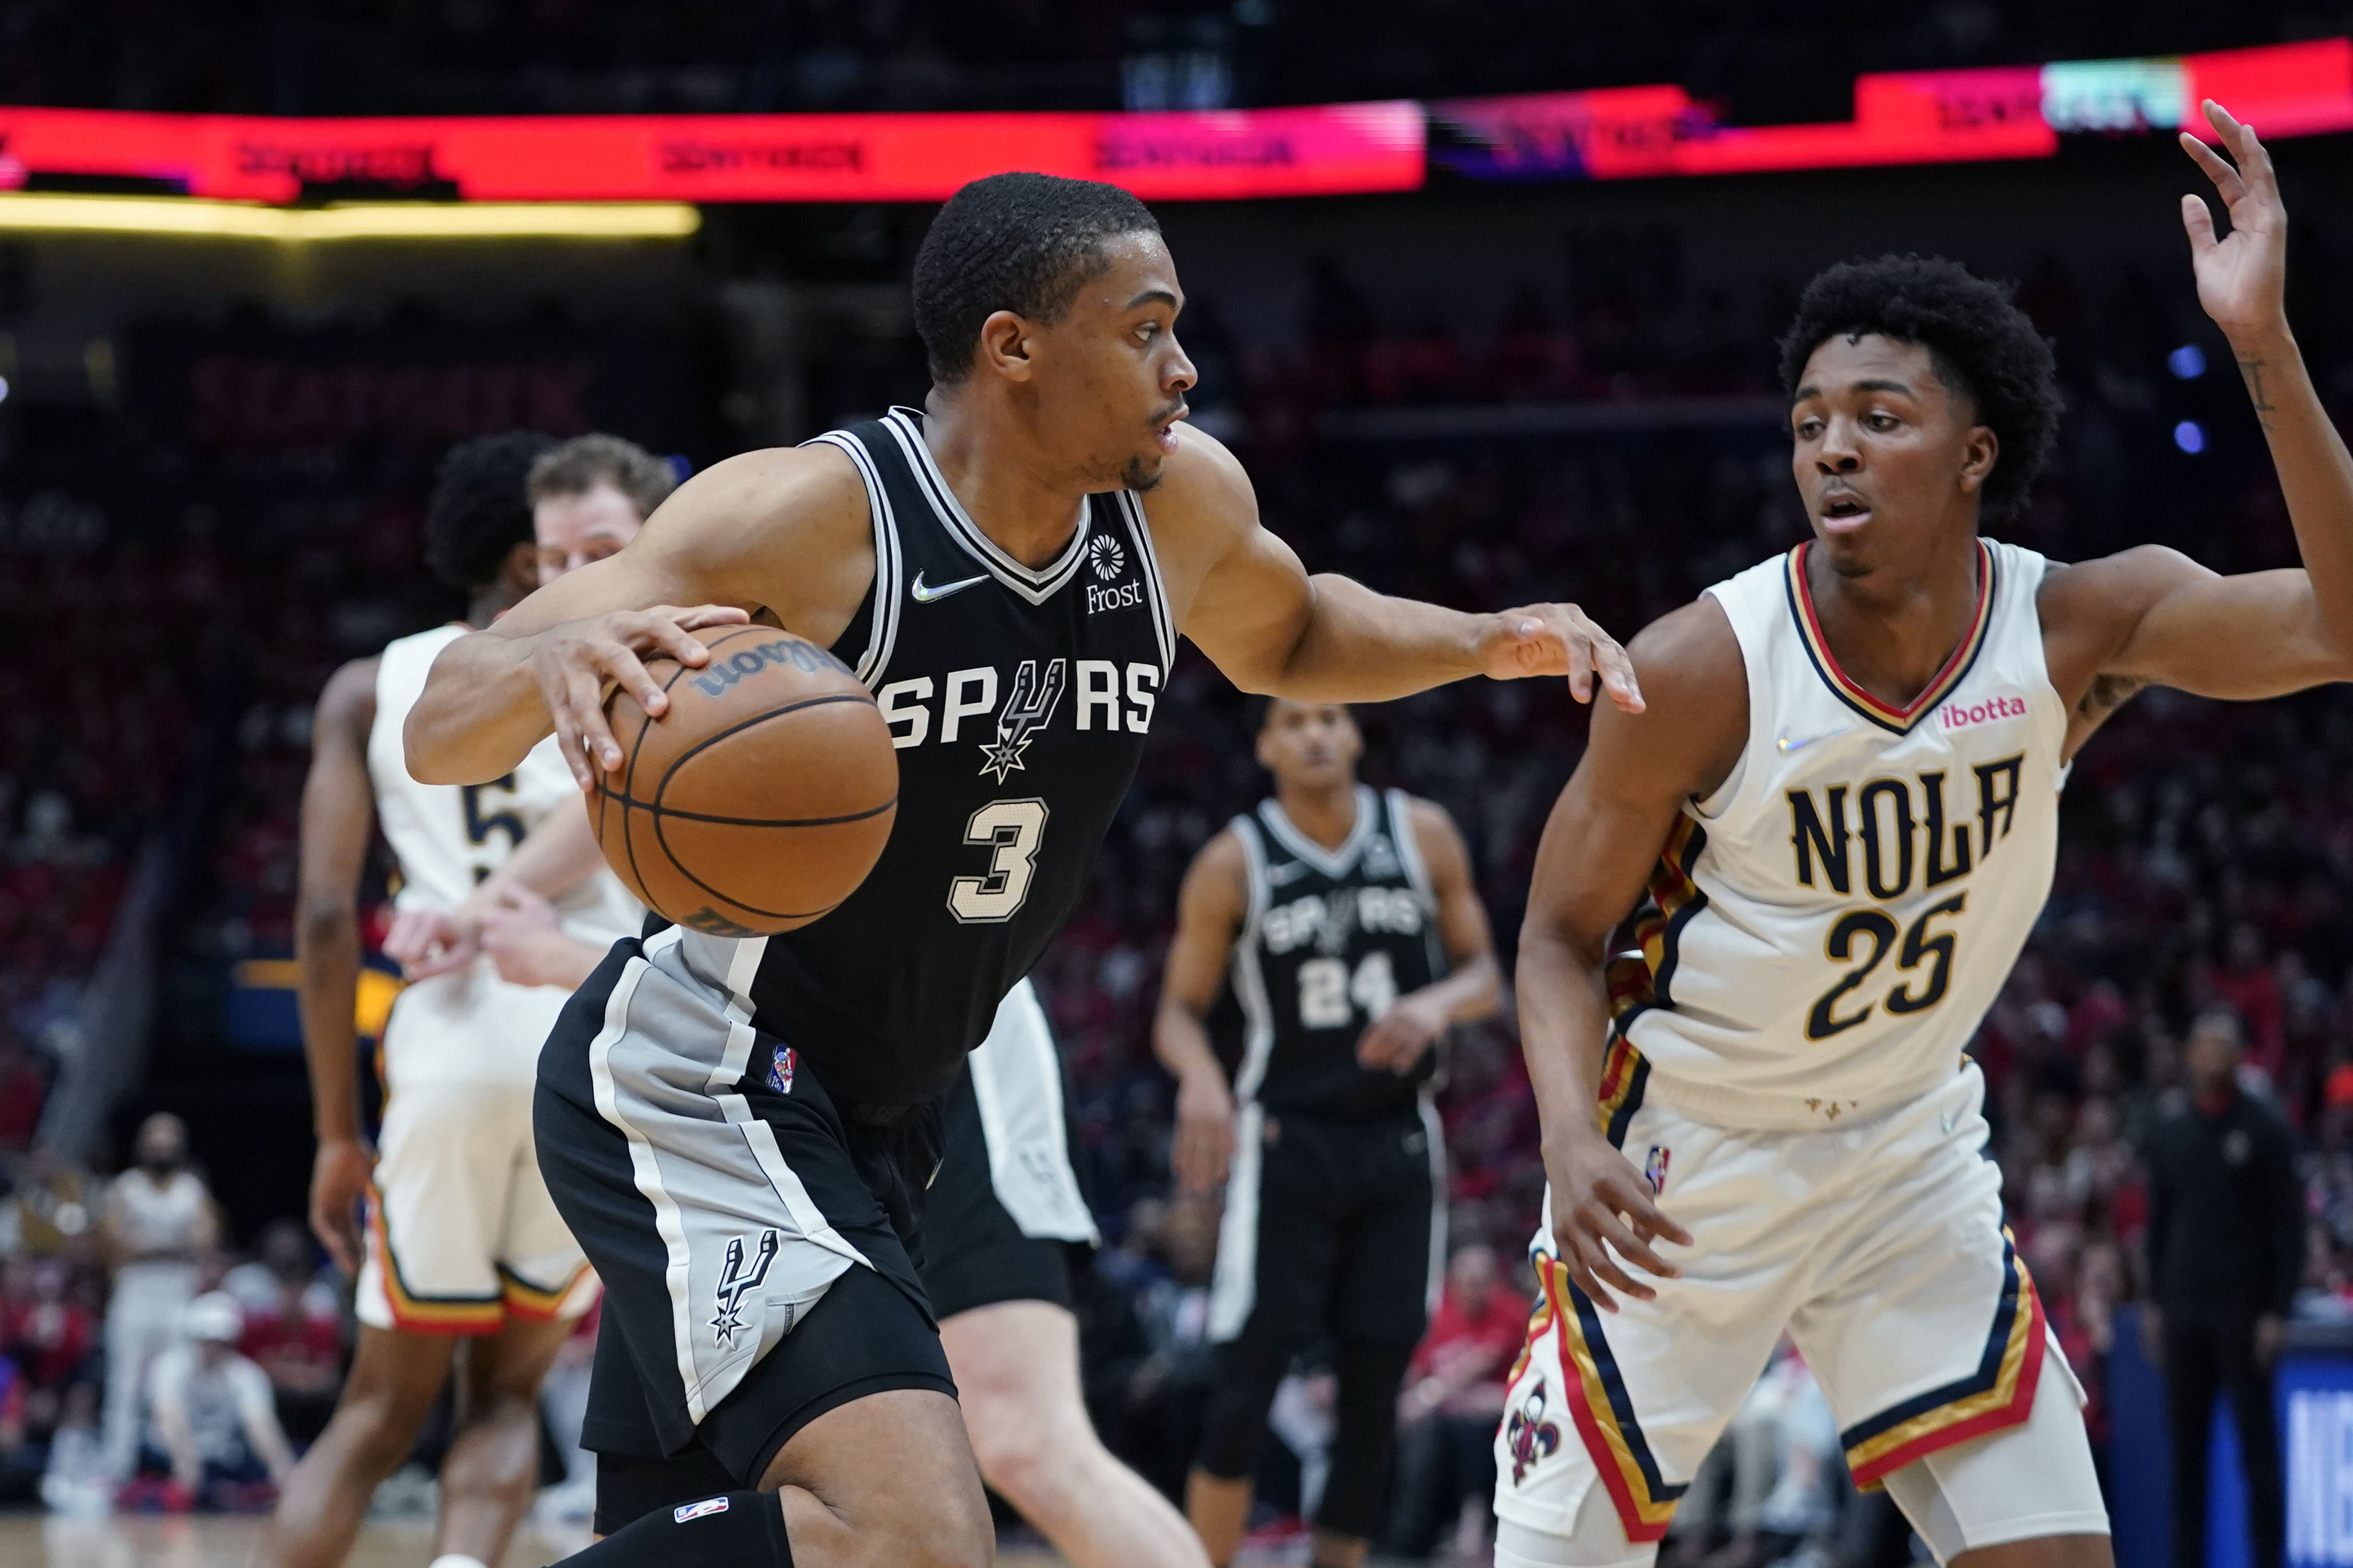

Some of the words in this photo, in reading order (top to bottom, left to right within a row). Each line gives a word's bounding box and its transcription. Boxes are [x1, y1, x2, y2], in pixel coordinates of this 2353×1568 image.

[1086, 578, 1142, 614] Frost
[690, 639, 861, 698] ilson
[877, 658, 1160, 785] SPURS
[1941, 695, 2026, 729] ibotta
[460, 771, 528, 886] 5
[946, 796, 1050, 923] 3
[1786, 748, 2026, 901] NOLA
[1295, 950, 1399, 1029] 24
[1804, 888, 1969, 1042] 25
